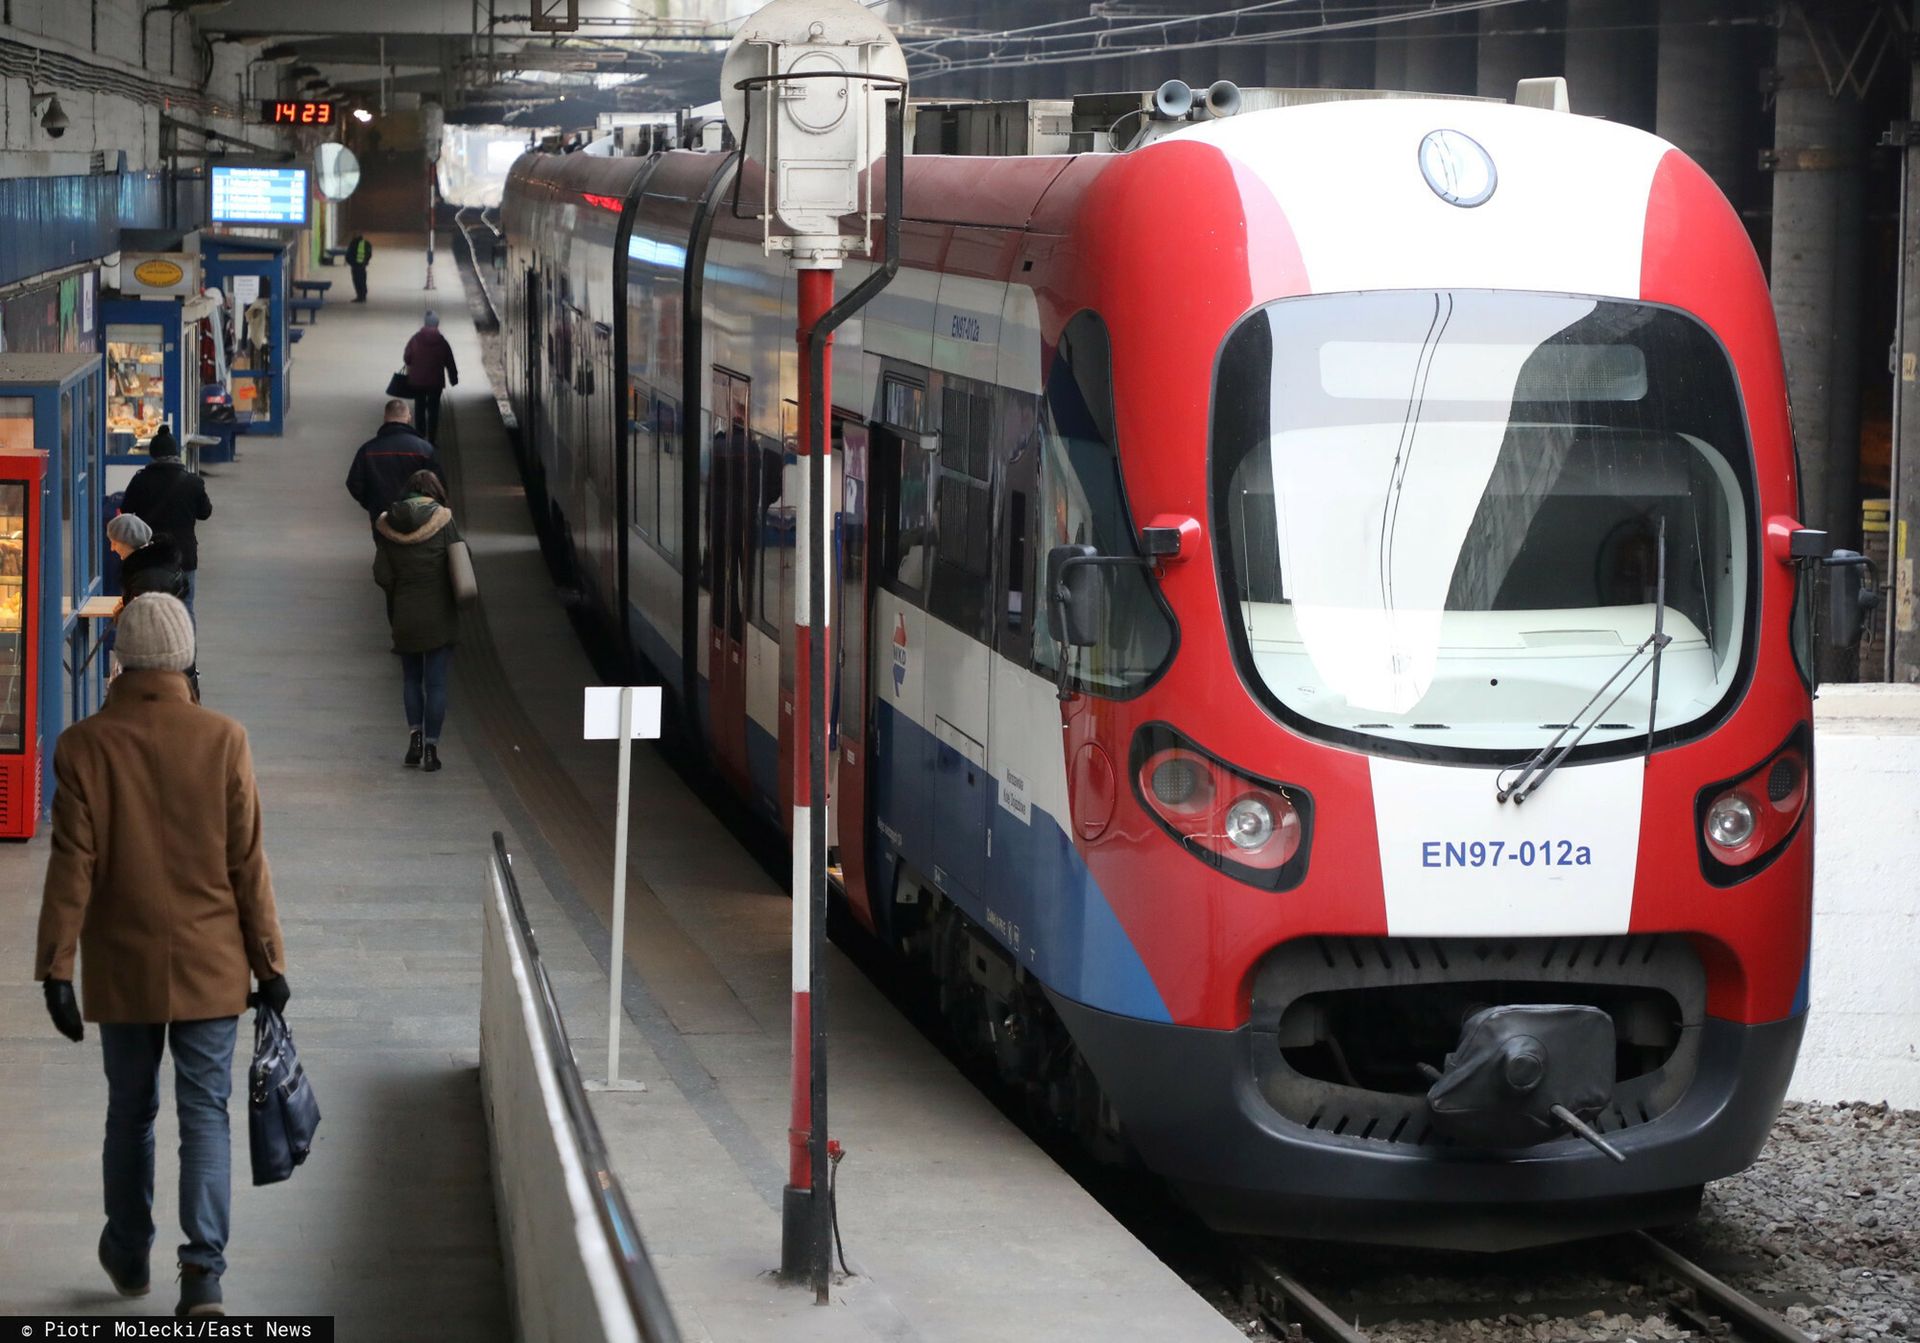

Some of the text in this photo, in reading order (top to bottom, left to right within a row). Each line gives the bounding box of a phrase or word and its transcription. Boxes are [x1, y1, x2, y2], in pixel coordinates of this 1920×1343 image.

[275, 103, 330, 123] 14 23
[951, 315, 980, 342] EN97-012a
[1422, 840, 1592, 868] EN97-012a
